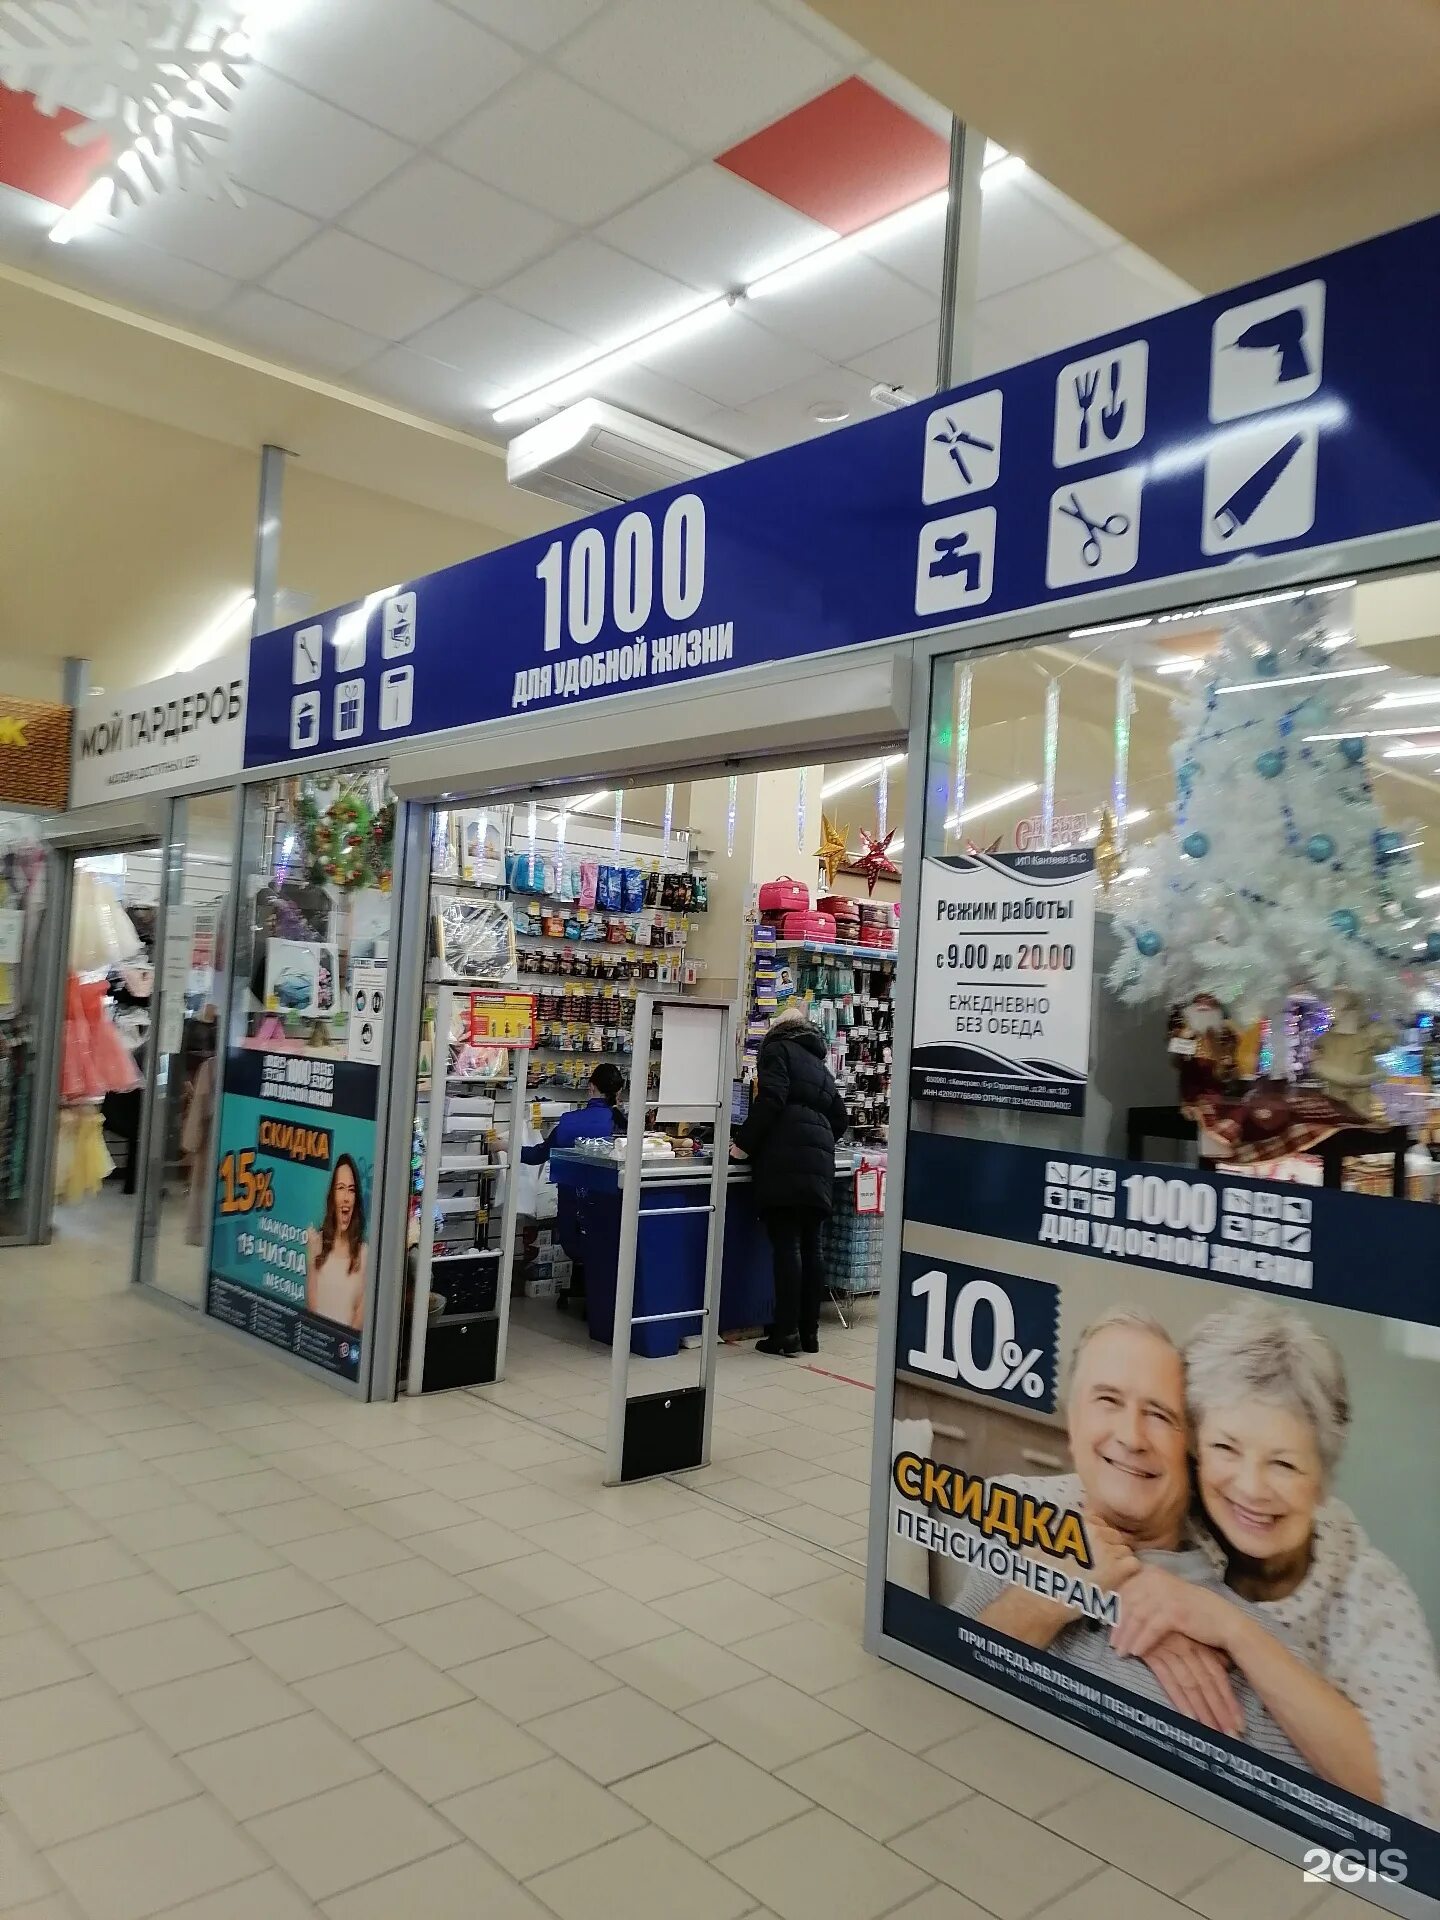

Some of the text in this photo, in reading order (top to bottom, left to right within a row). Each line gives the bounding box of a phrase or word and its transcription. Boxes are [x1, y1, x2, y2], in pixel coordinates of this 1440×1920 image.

[536, 493, 706, 652] 1000
[511, 621, 734, 709] ДЛЯ УДОБНОЙ ЖИЗНИ
[79, 710, 123, 760] МОЙ
[128, 679, 244, 747] ГАРДЕРОБ
[936, 896, 1075, 923] Режим работы
[936, 943, 1075, 972] с 9.00 до 20.00
[948, 994, 1051, 1016] ЕЖЕДНЕВНО
[956, 1016, 1045, 1040] БЕЗ ОБЕДА
[260, 1120, 330, 1161] СКИДКА
[219, 1150, 274, 1213] 15%
[1121, 1174, 1218, 1235] 1000
[238, 1232, 307, 1277] 15 ЧИСЛА
[260, 1216, 309, 1246] КАЖДОГО
[1038, 1213, 1315, 1291] ДЛЯ УДОБНОЙ ЖИЗНИ
[264, 1272, 305, 1301] МЕСЯЦА
[907, 1269, 1046, 1399] 10%
[894, 1452, 1093, 1569] СКИДКА
[896, 1505, 1121, 1626] ПЕНСИОНЕРАМ
[957, 1627, 987, 1652] ПРИ
[986, 1640, 1102, 1705] ПРЕДЪЯВЛЕНИИ
[1101, 1693, 1228, 1764] ПЕНСИОННОГО
